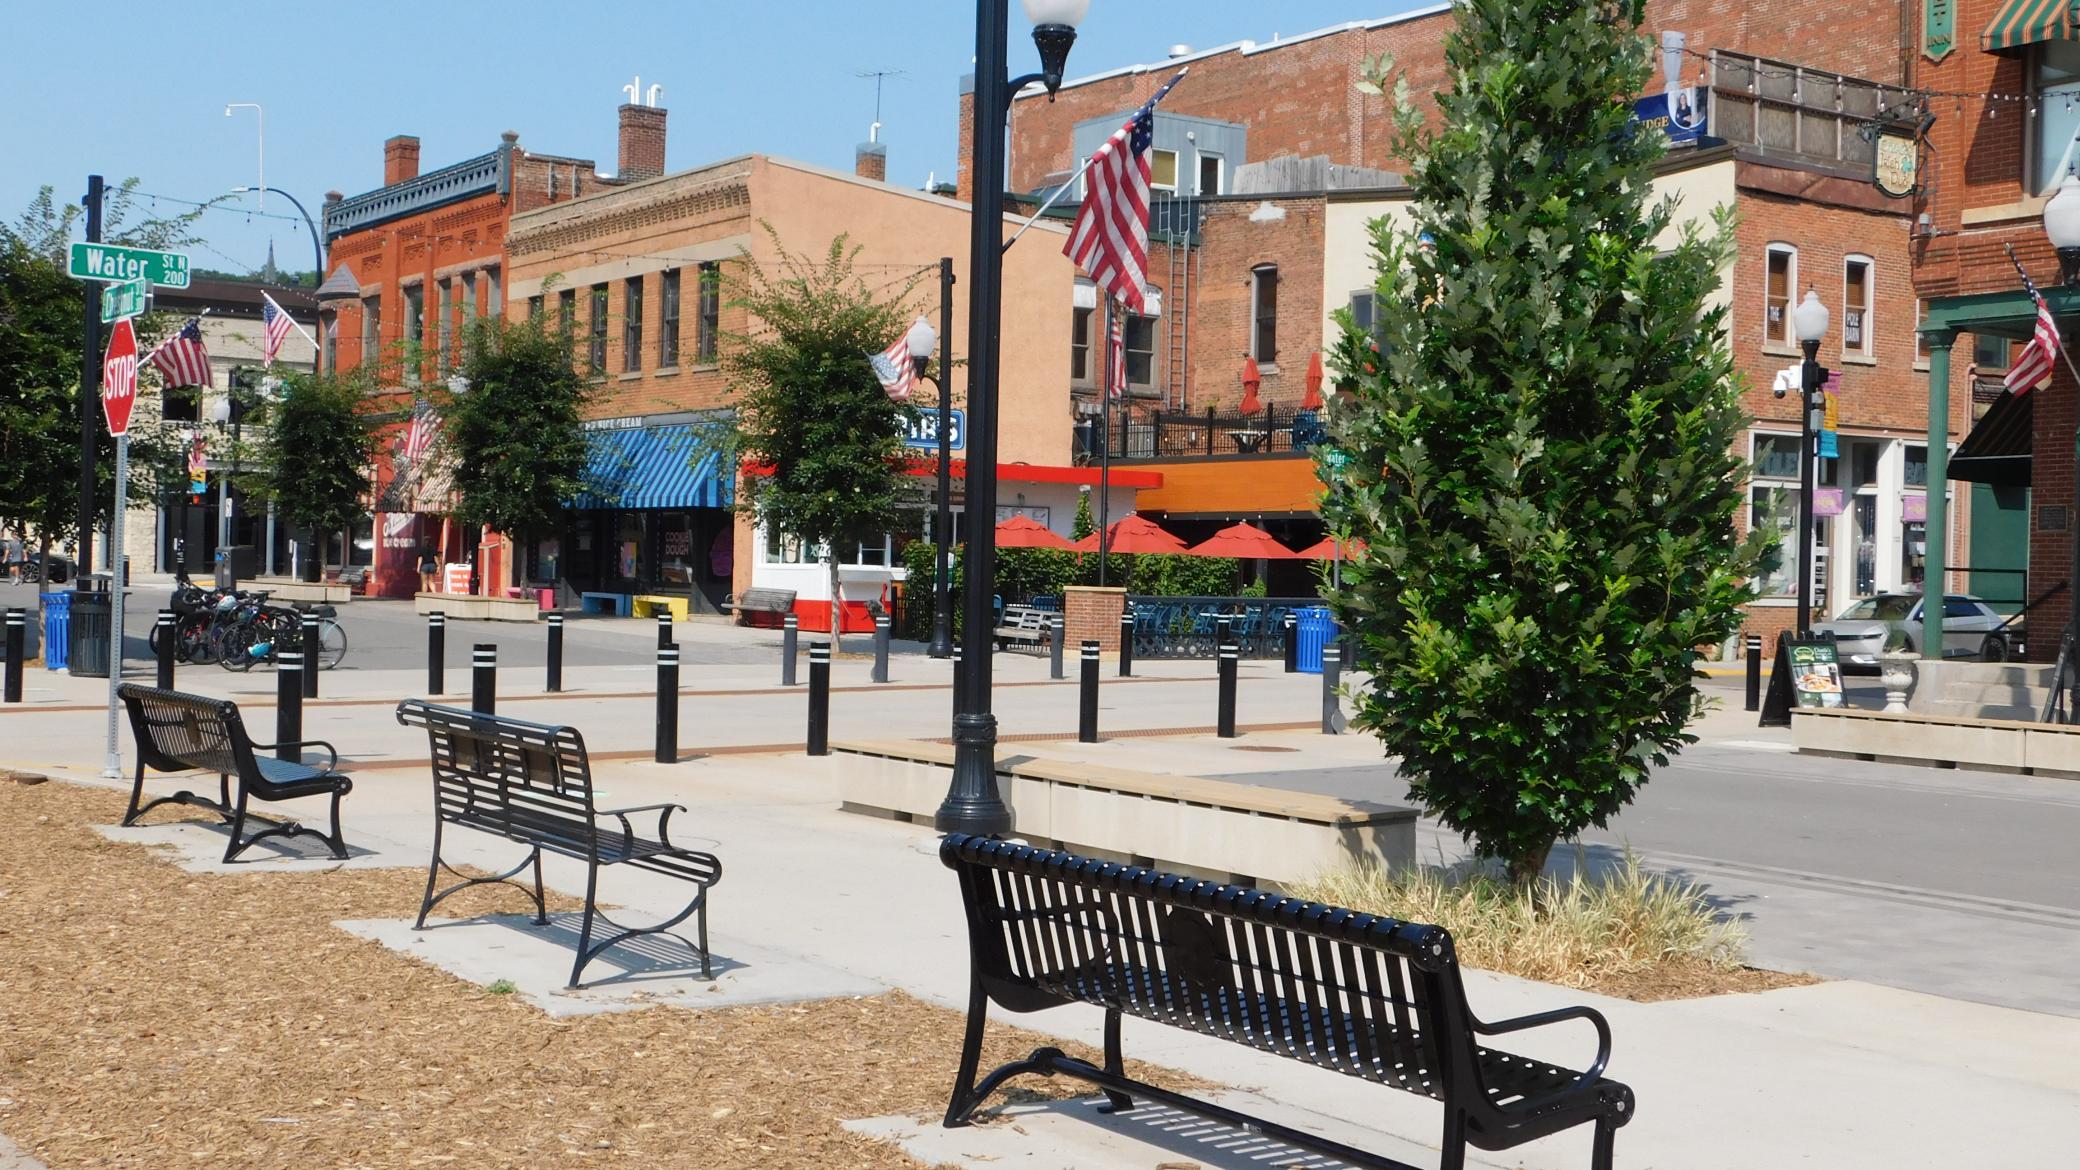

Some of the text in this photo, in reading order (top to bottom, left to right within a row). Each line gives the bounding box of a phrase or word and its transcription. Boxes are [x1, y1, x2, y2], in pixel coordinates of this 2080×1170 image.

[1927, 35, 1951, 48] INN
[1641, 115, 1670, 129] DGE
[86, 248, 186, 279] Water St N
[164, 271, 184, 285] 200
[1769, 306, 1781, 321] THE
[106, 355, 134, 399] STOP
[616, 416, 642, 428] CREAM
[665, 543, 689, 555] DOUGH
